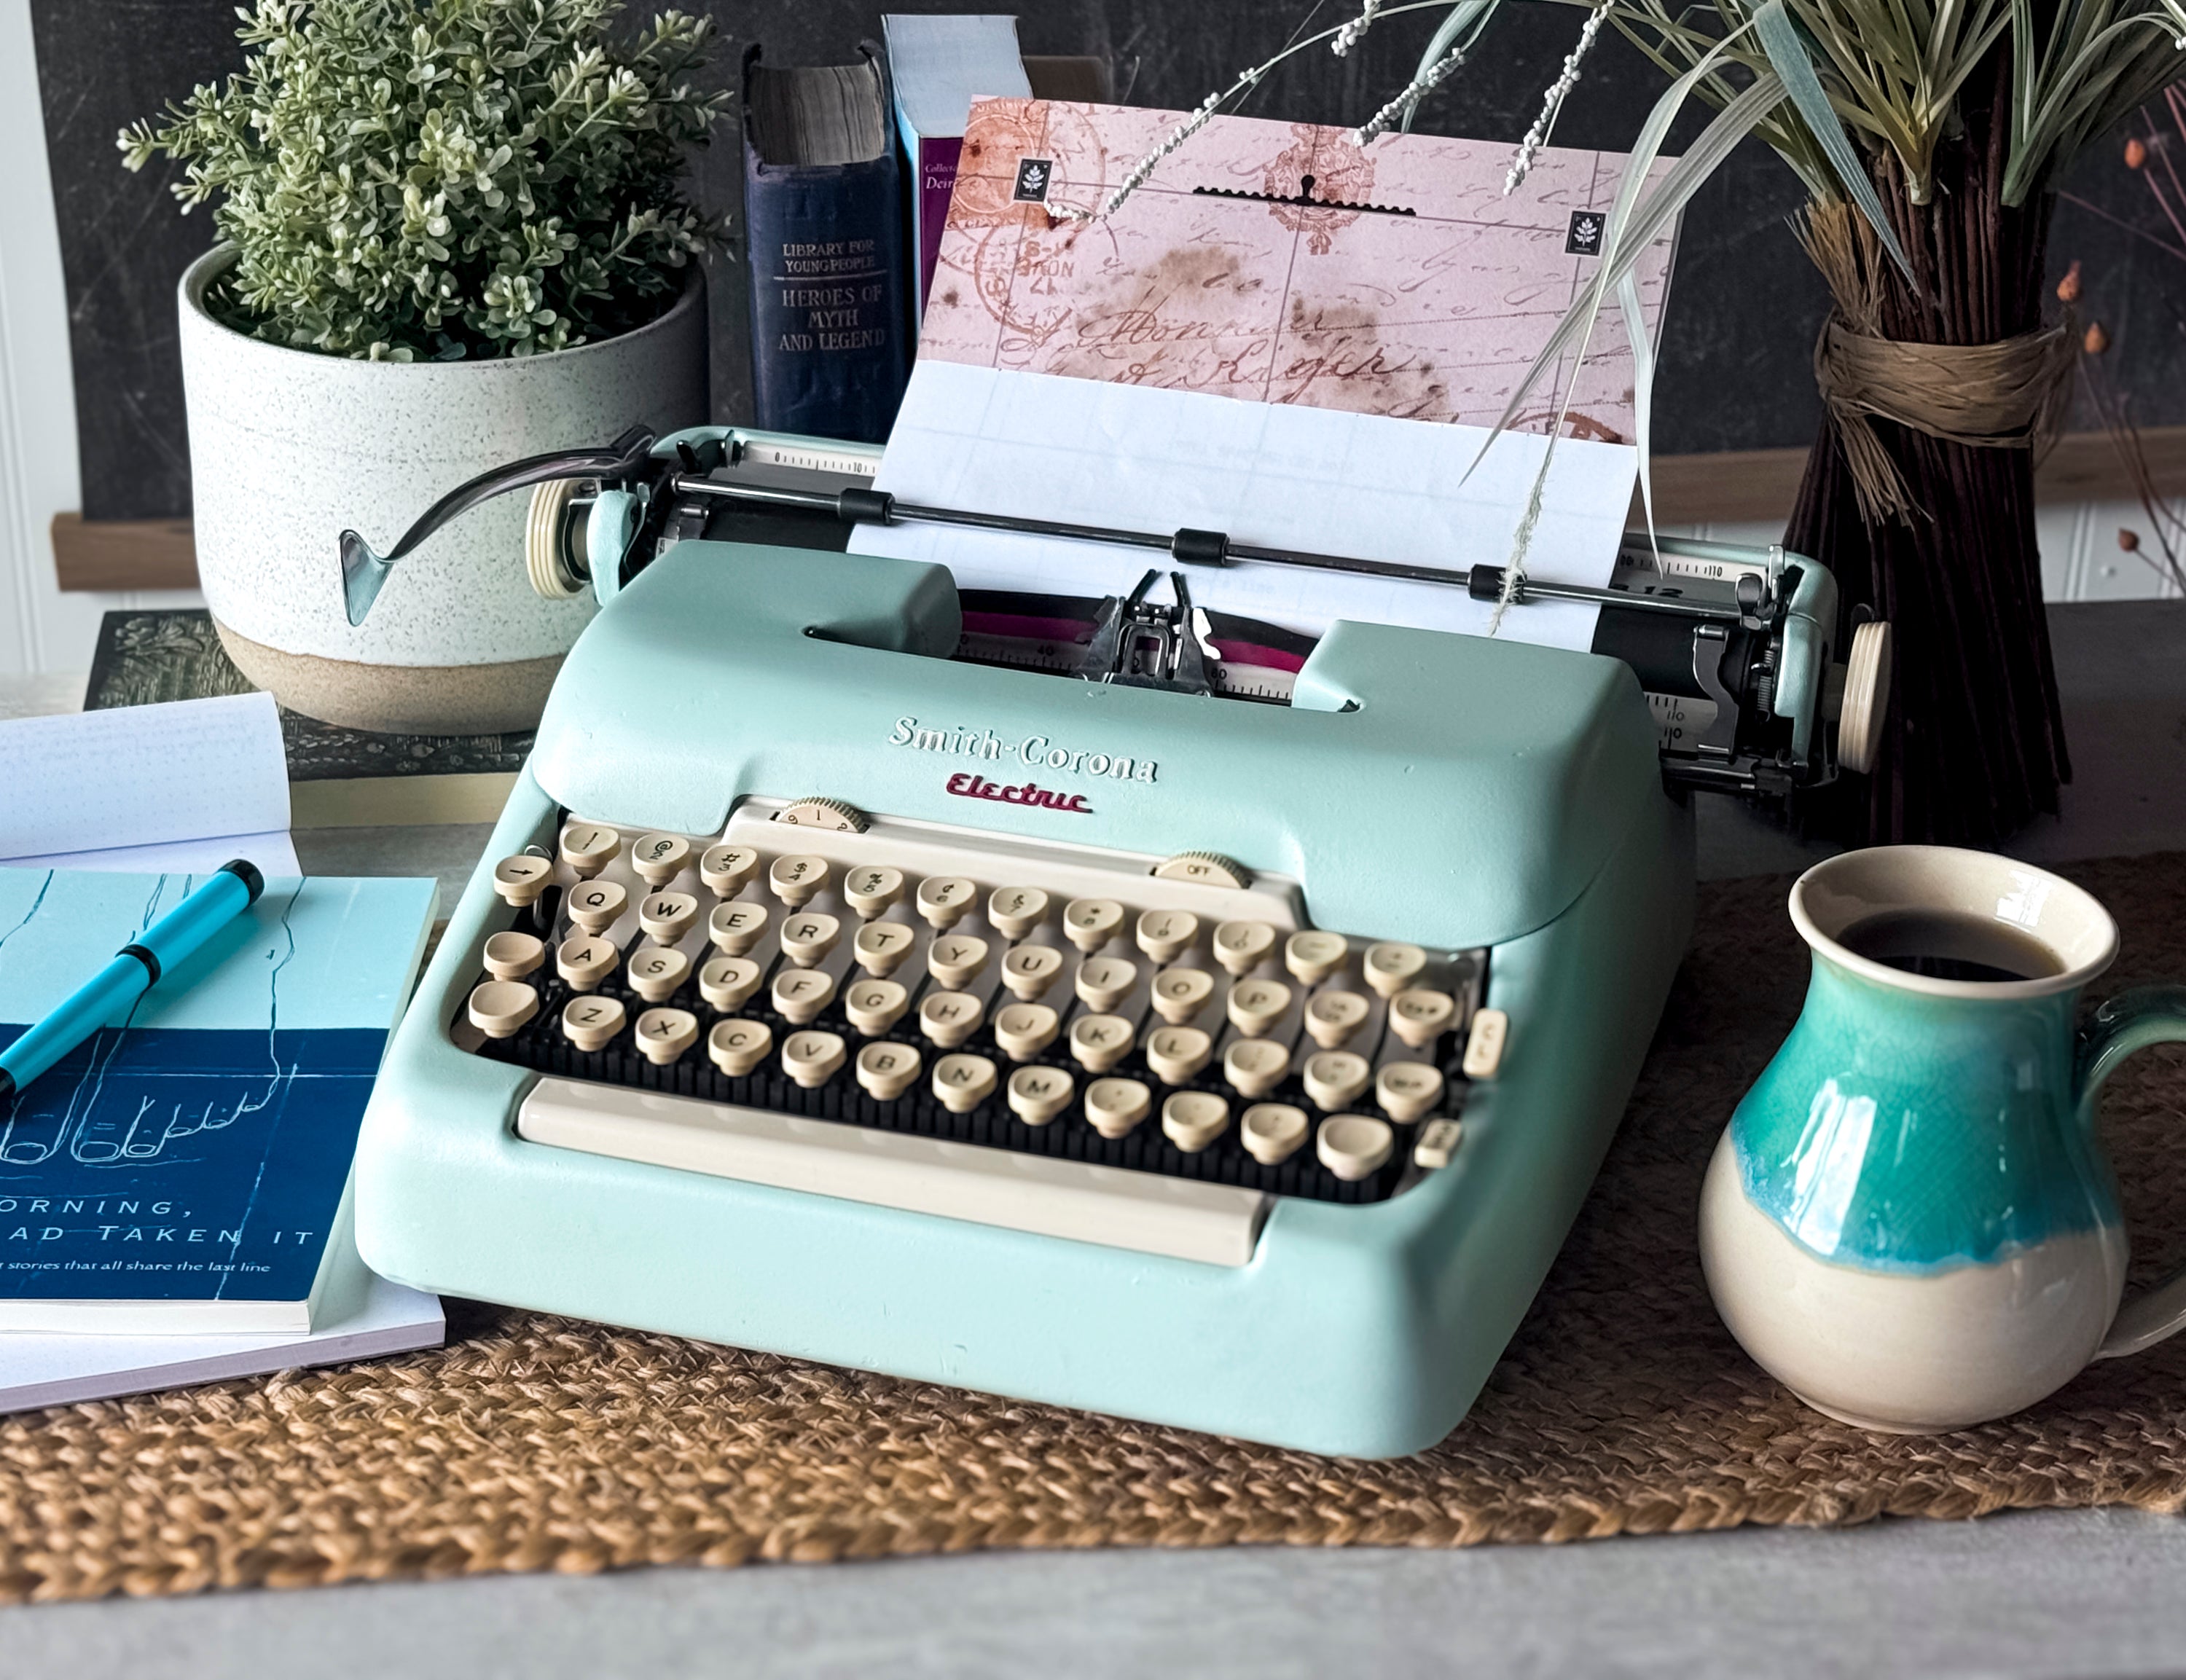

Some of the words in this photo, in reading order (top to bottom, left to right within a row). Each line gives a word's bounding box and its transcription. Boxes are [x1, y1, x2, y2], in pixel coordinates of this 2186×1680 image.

[783, 243, 845, 256] LIBRARY
[849, 240, 874, 254] FOR
[782, 287, 855, 307] HEROES
[862, 284, 882, 302] OF
[808, 309, 858, 328] MYTH
[779, 334, 812, 351] AND
[819, 329, 885, 350] LEGEND
[775, 452, 780, 462] 0
[854, 462, 863, 473] 10
[889, 716, 1159, 784] Smith-Corona
[947, 773, 1093, 814] Electric
[816, 809, 820, 820] 1
[655, 839, 673, 852] @
[794, 861, 808, 874] $
[587, 892, 606, 906] Q
[657, 902, 682, 917] W
[726, 913, 747, 927] E
[798, 924, 818, 938] R
[877, 933, 895, 947] T
[950, 947, 968, 961] Y
[1022, 956, 1043, 971] U
[1100, 971, 1110, 983] I
[1172, 981, 1191, 995] O
[1247, 991, 1269, 1006] P
[573, 949, 593, 962] A
[647, 959, 666, 973] S
[718, 970, 740, 984] D
[790, 980, 812, 994] F
[866, 993, 885, 1007] G
[939, 1004, 960, 1018] H
[1016, 1019, 1035, 1032] J
[1090, 1028, 1110, 1043] K
[1167, 1039, 1183, 1053] L
[580, 1008, 603, 1022] Z
[651, 1020, 676, 1035] X
[728, 1033, 748, 1046] C
[805, 1043, 823, 1056] V
[875, 1055, 896, 1069] B
[952, 1067, 974, 1082] N
[1027, 1079, 1051, 1094] M
[98, 1225, 240, 1242] TAKEN
[273, 1231, 313, 1244] IT
[7, 1260, 60, 1270] stories
[65, 1260, 98, 1270] that
[101, 1260, 122, 1270] all
[126, 1260, 173, 1271] share
[177, 1261, 203, 1271] the
[208, 1262, 235, 1271] last
[240, 1262, 271, 1272] line
